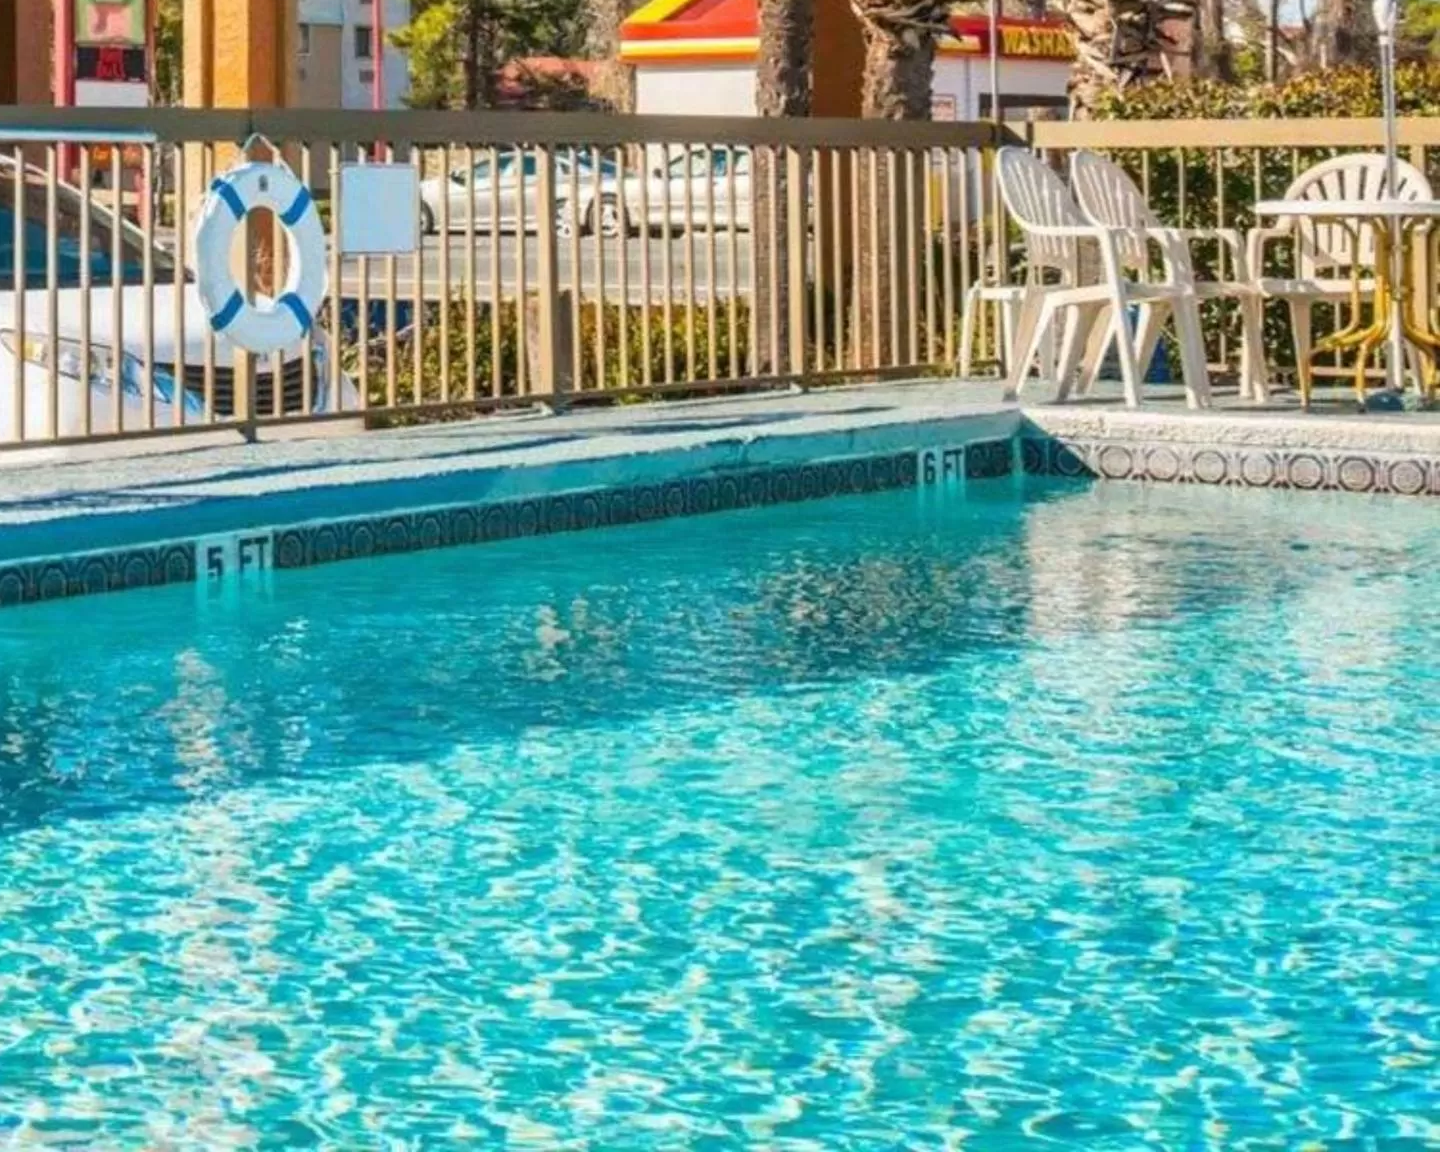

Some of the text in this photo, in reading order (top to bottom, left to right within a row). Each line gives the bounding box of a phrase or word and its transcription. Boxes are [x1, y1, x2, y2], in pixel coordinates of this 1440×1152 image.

[923, 448, 963, 485] 6 FT
[206, 535, 270, 577] 5 FT
